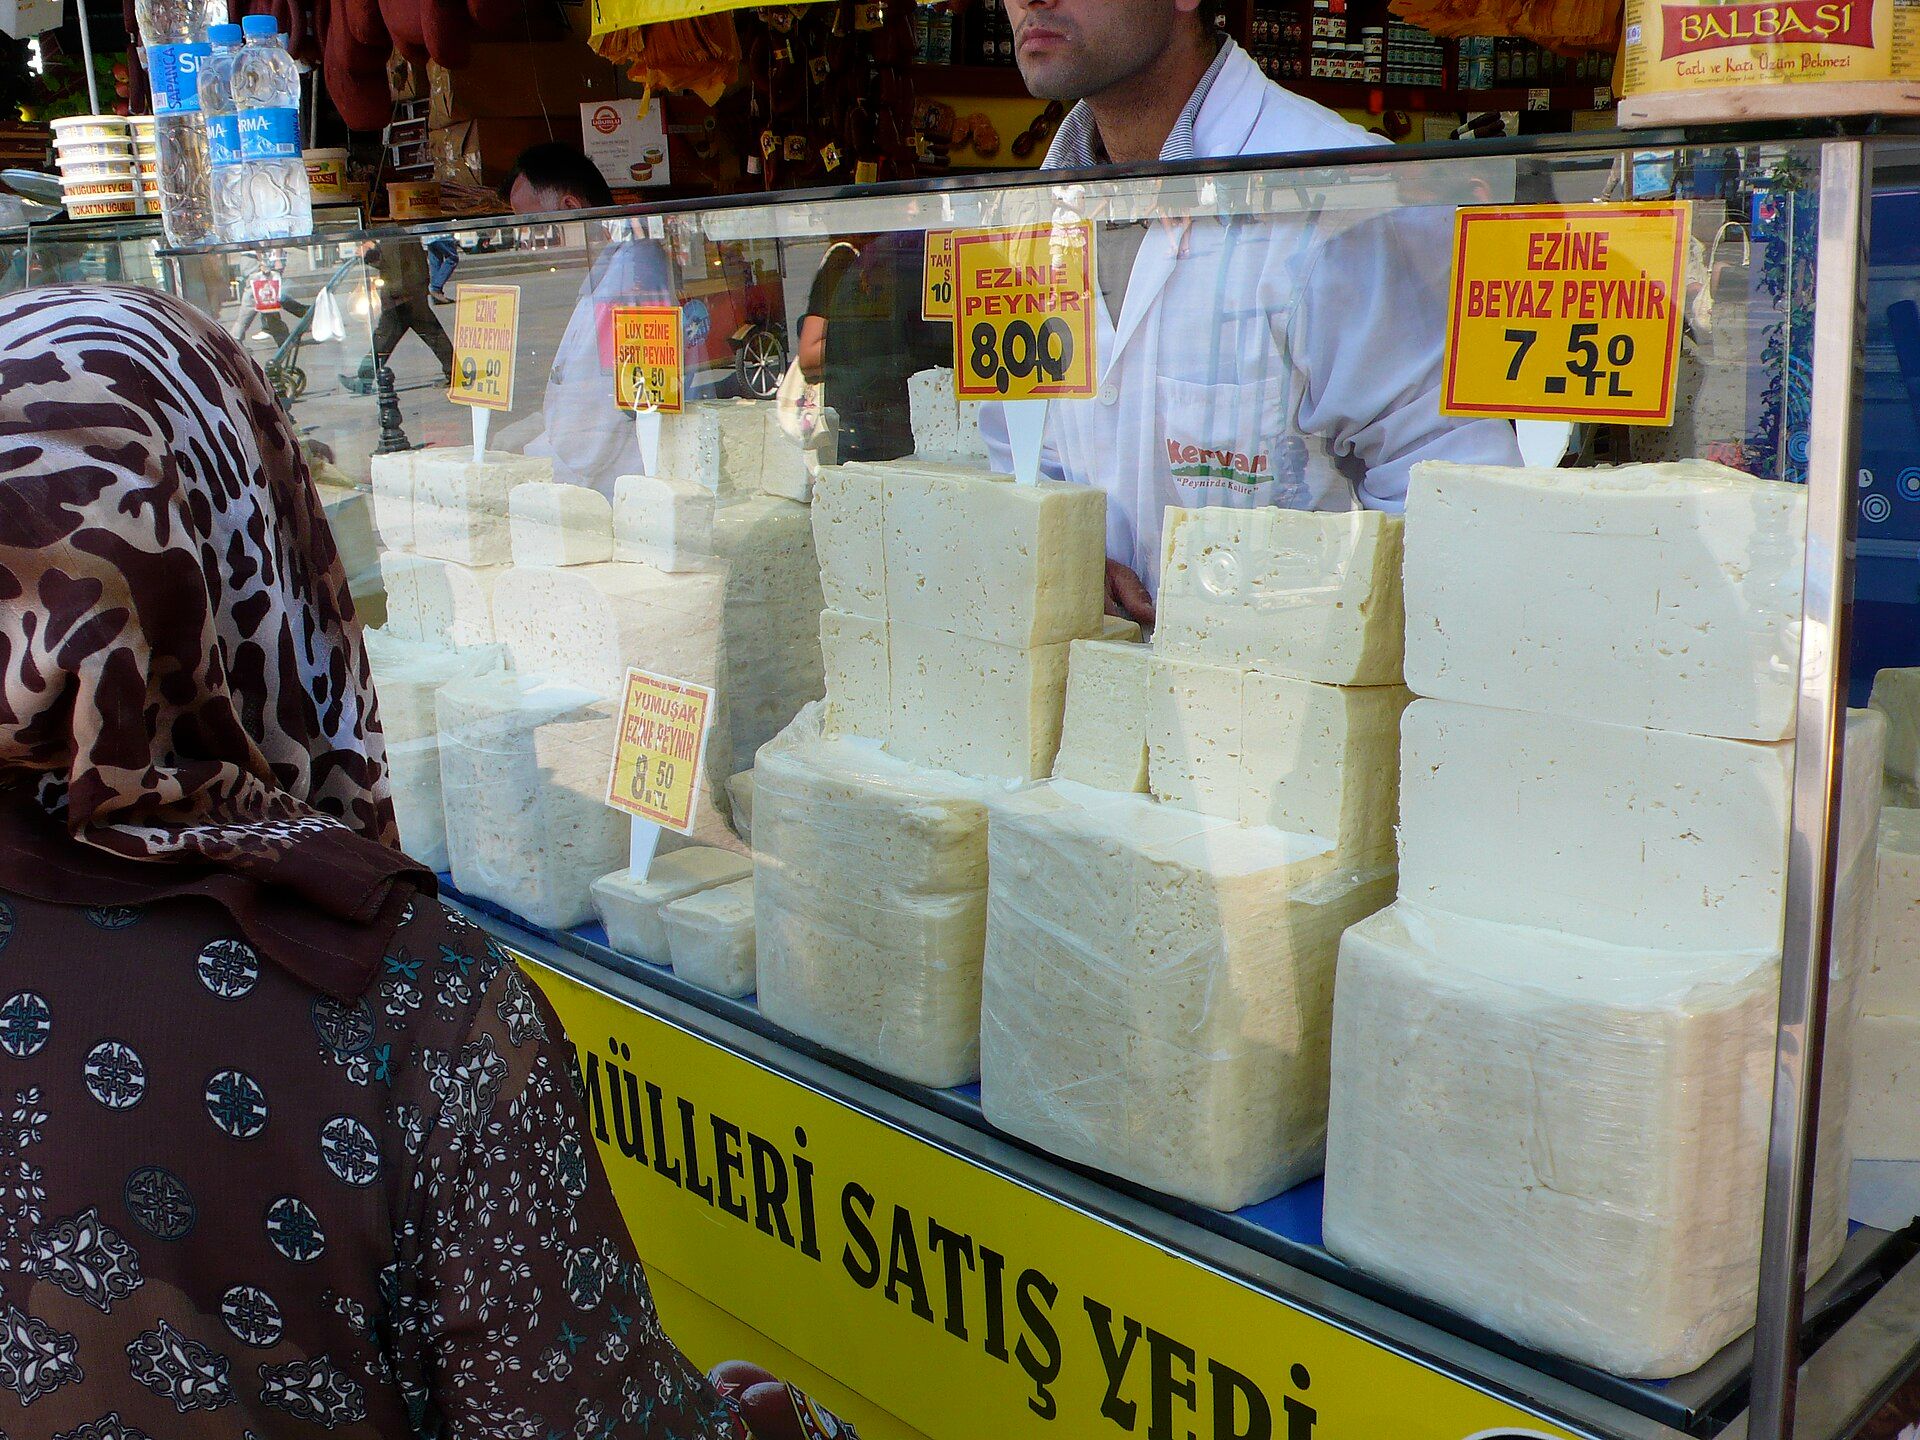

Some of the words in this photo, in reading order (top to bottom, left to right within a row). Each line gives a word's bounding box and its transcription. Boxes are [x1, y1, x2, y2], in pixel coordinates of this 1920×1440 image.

[1680, 3, 1851, 42] BALBAŞI
[1711, 64, 1721, 74] ve
[1759, 52, 1795, 71] Üzüm
[1801, 52, 1851, 73] Pekmezi
[162, 47, 182, 109] SAPANCA
[1527, 222, 1609, 271] EZİNE
[976, 262, 1067, 289] EZİNE
[475, 295, 498, 323] EZİNE
[965, 287, 1081, 316] PEYNİR
[1467, 280, 1554, 318] BEYAZ
[1561, 270, 1666, 319] PEYNİR
[459, 325, 482, 349] BEYAZ
[483, 323, 512, 352] PEYNİR
[624, 319, 641, 339] LÜX
[643, 319, 670, 340] EZİNE
[619, 345, 641, 365] SERT
[643, 342, 676, 366] PEYNİR
[486, 379, 500, 396] TL
[651, 389, 665, 403] TL
[1166, 438, 1268, 474] Kervan
[634, 689, 698, 725] YUMUŞAK
[625, 711, 656, 750] EZİNE
[653, 721, 695, 762] PEYNİR
[840, 1180, 1063, 1421] SATIŞ
